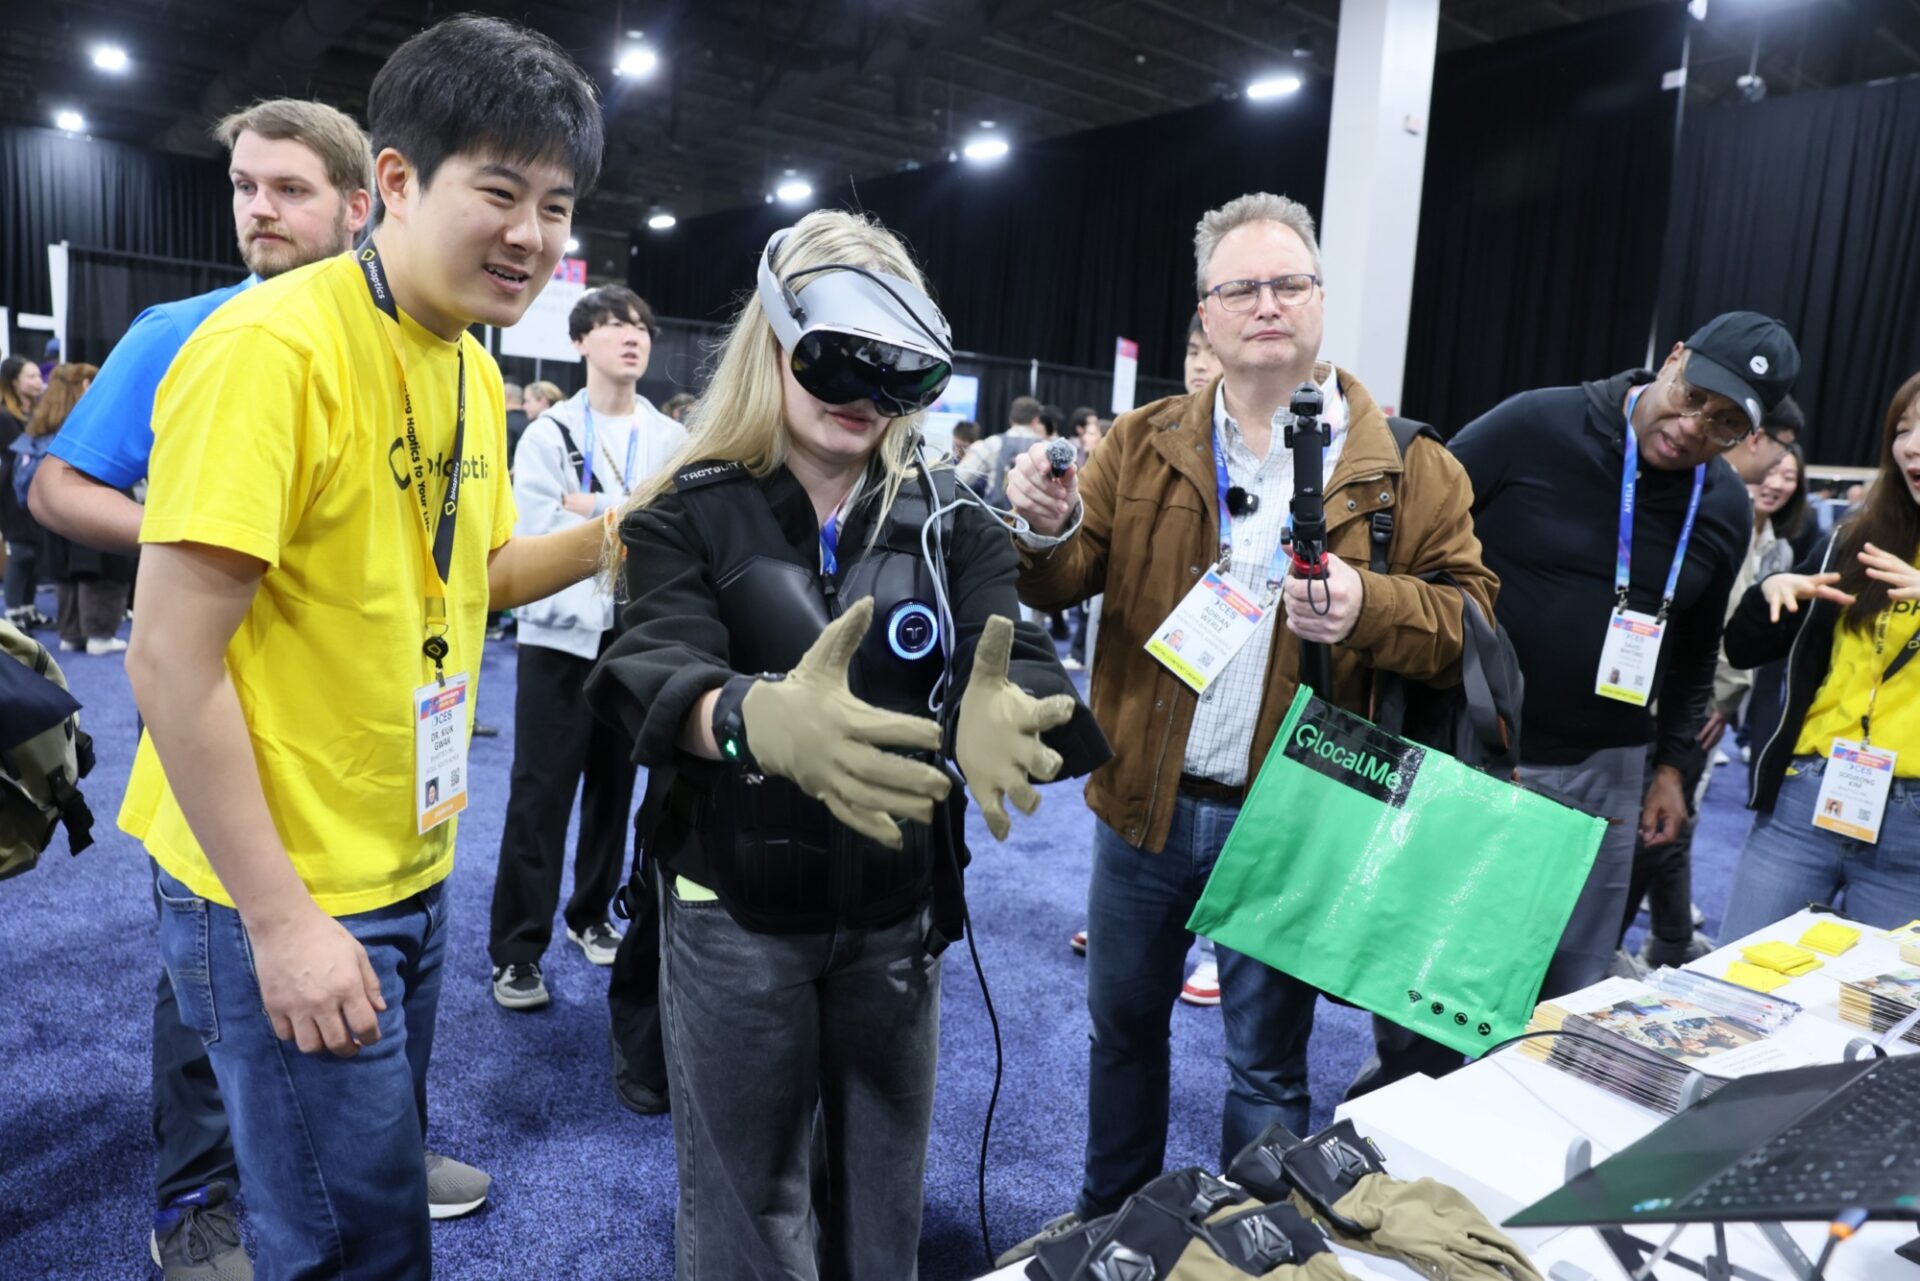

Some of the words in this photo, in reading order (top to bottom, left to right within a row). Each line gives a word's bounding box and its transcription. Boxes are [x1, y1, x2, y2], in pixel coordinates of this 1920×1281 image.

[366, 260, 386, 300] bHaptics
[406, 417, 421, 463] Haptics
[414, 465, 426, 478] to
[451, 461, 460, 501] bHaptics
[417, 480, 428, 508] Your
[1624, 482, 1634, 513] AFEELA
[1204, 606, 1231, 628] ADRIAN
[1219, 603, 1238, 619] CES
[439, 710, 453, 724] CES
[1295, 724, 1403, 790] GlocalMe
